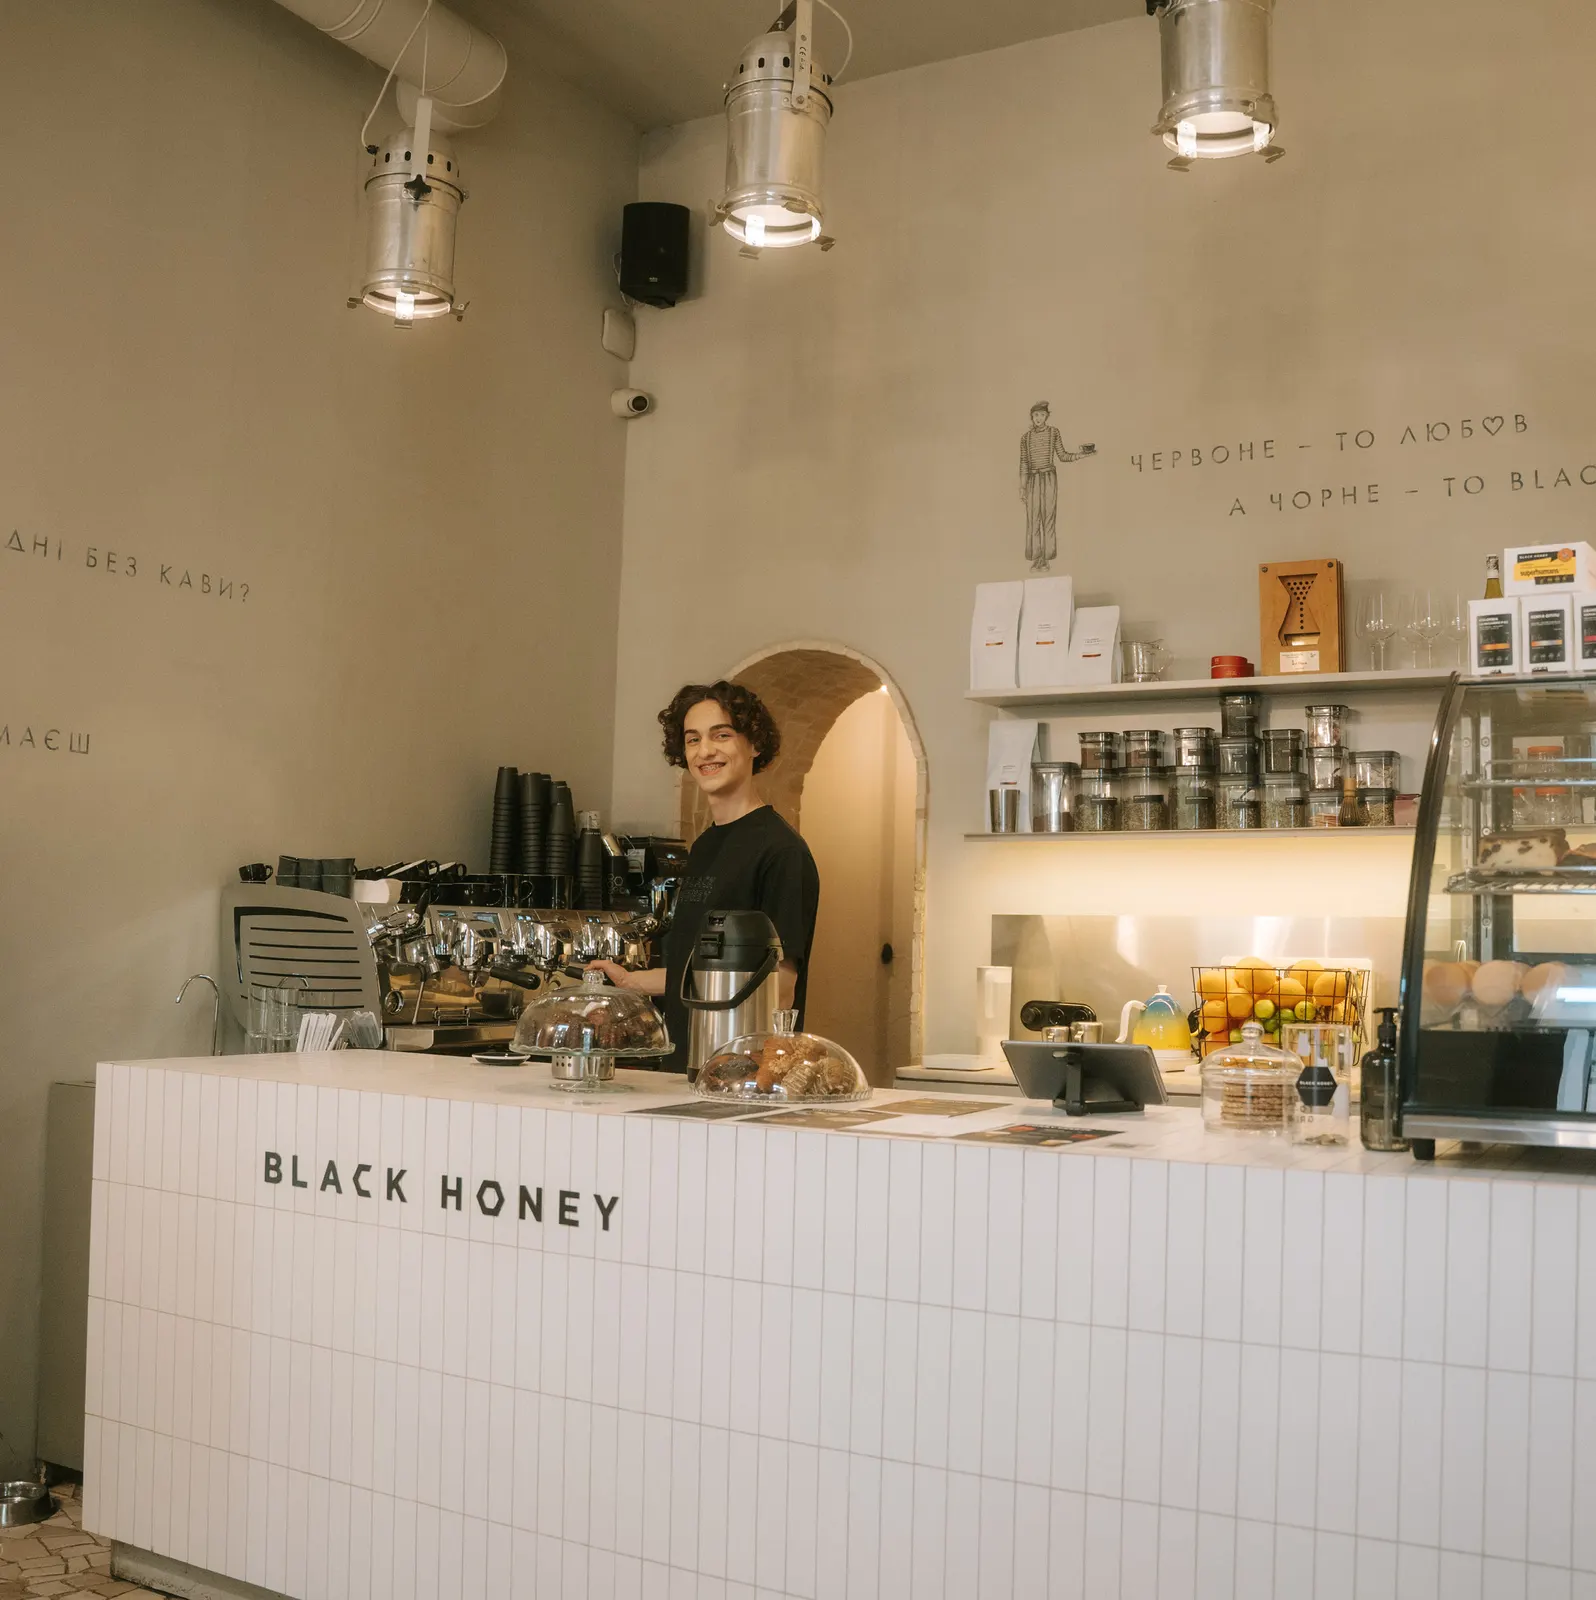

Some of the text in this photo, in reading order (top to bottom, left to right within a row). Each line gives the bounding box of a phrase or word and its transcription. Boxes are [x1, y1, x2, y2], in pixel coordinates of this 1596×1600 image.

[1131, 439, 1275, 473] ЧЕРВОНЕ
[1336, 429, 1375, 451] ТО
[1229, 497, 1246, 516] А
[1270, 484, 1379, 511] ЧОРНЕ
[1443, 475, 1485, 497] ТО
[86, 547, 137, 577] БЕЗ
[160, 564, 250, 602] КАВИ?
[264, 1151, 620, 1231] BLACK HONEY
